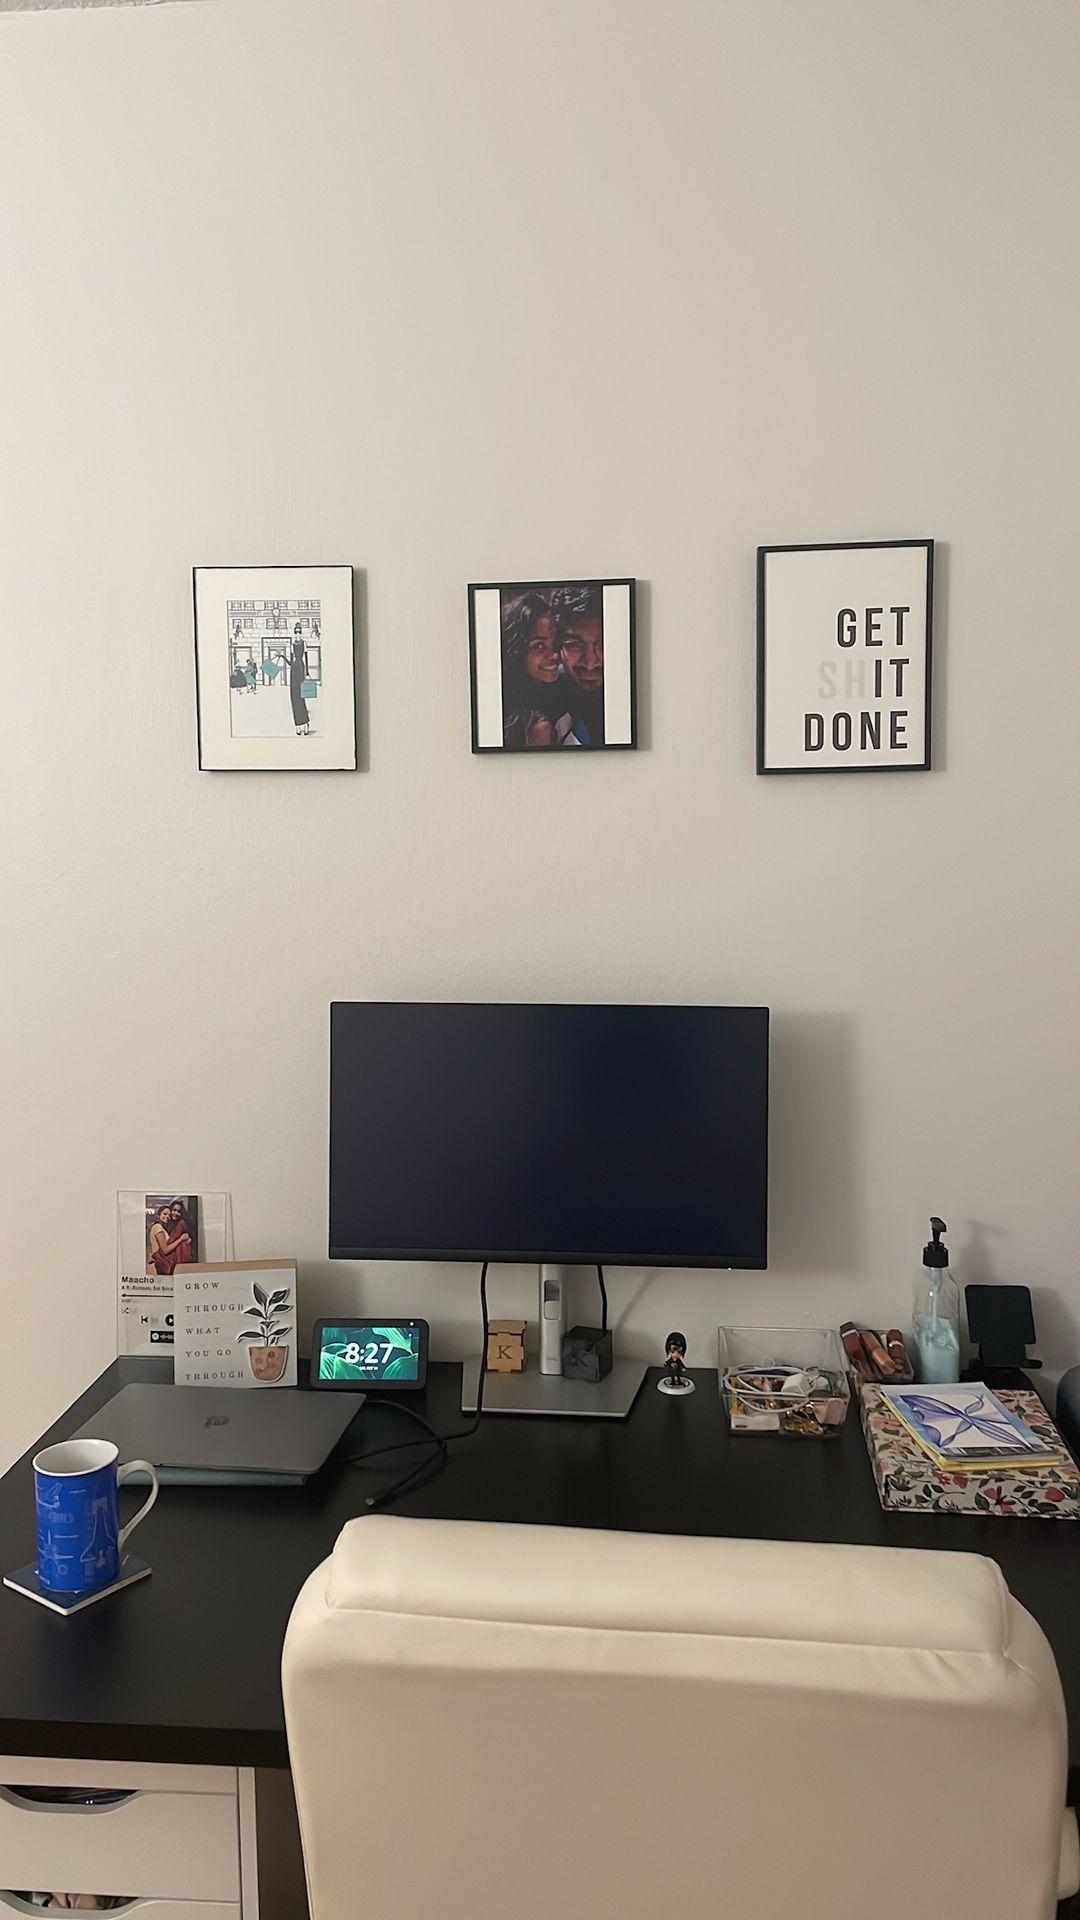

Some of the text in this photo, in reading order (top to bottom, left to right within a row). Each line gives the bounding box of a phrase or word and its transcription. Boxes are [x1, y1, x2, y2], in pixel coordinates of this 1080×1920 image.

[837, 606, 910, 648] GET
[804, 710, 908, 751] DONE
[121, 1276, 155, 1284] Maacho
[185, 1281, 220, 1290] GROW
[185, 1303, 244, 1313] THROUGH
[185, 1327, 222, 1335] WHAT
[185, 1349, 232, 1358] YOU GO
[345, 1342, 394, 1364] 8:27
[497, 1345, 513, 1360] K
[185, 1371, 244, 1381] THROUGH
